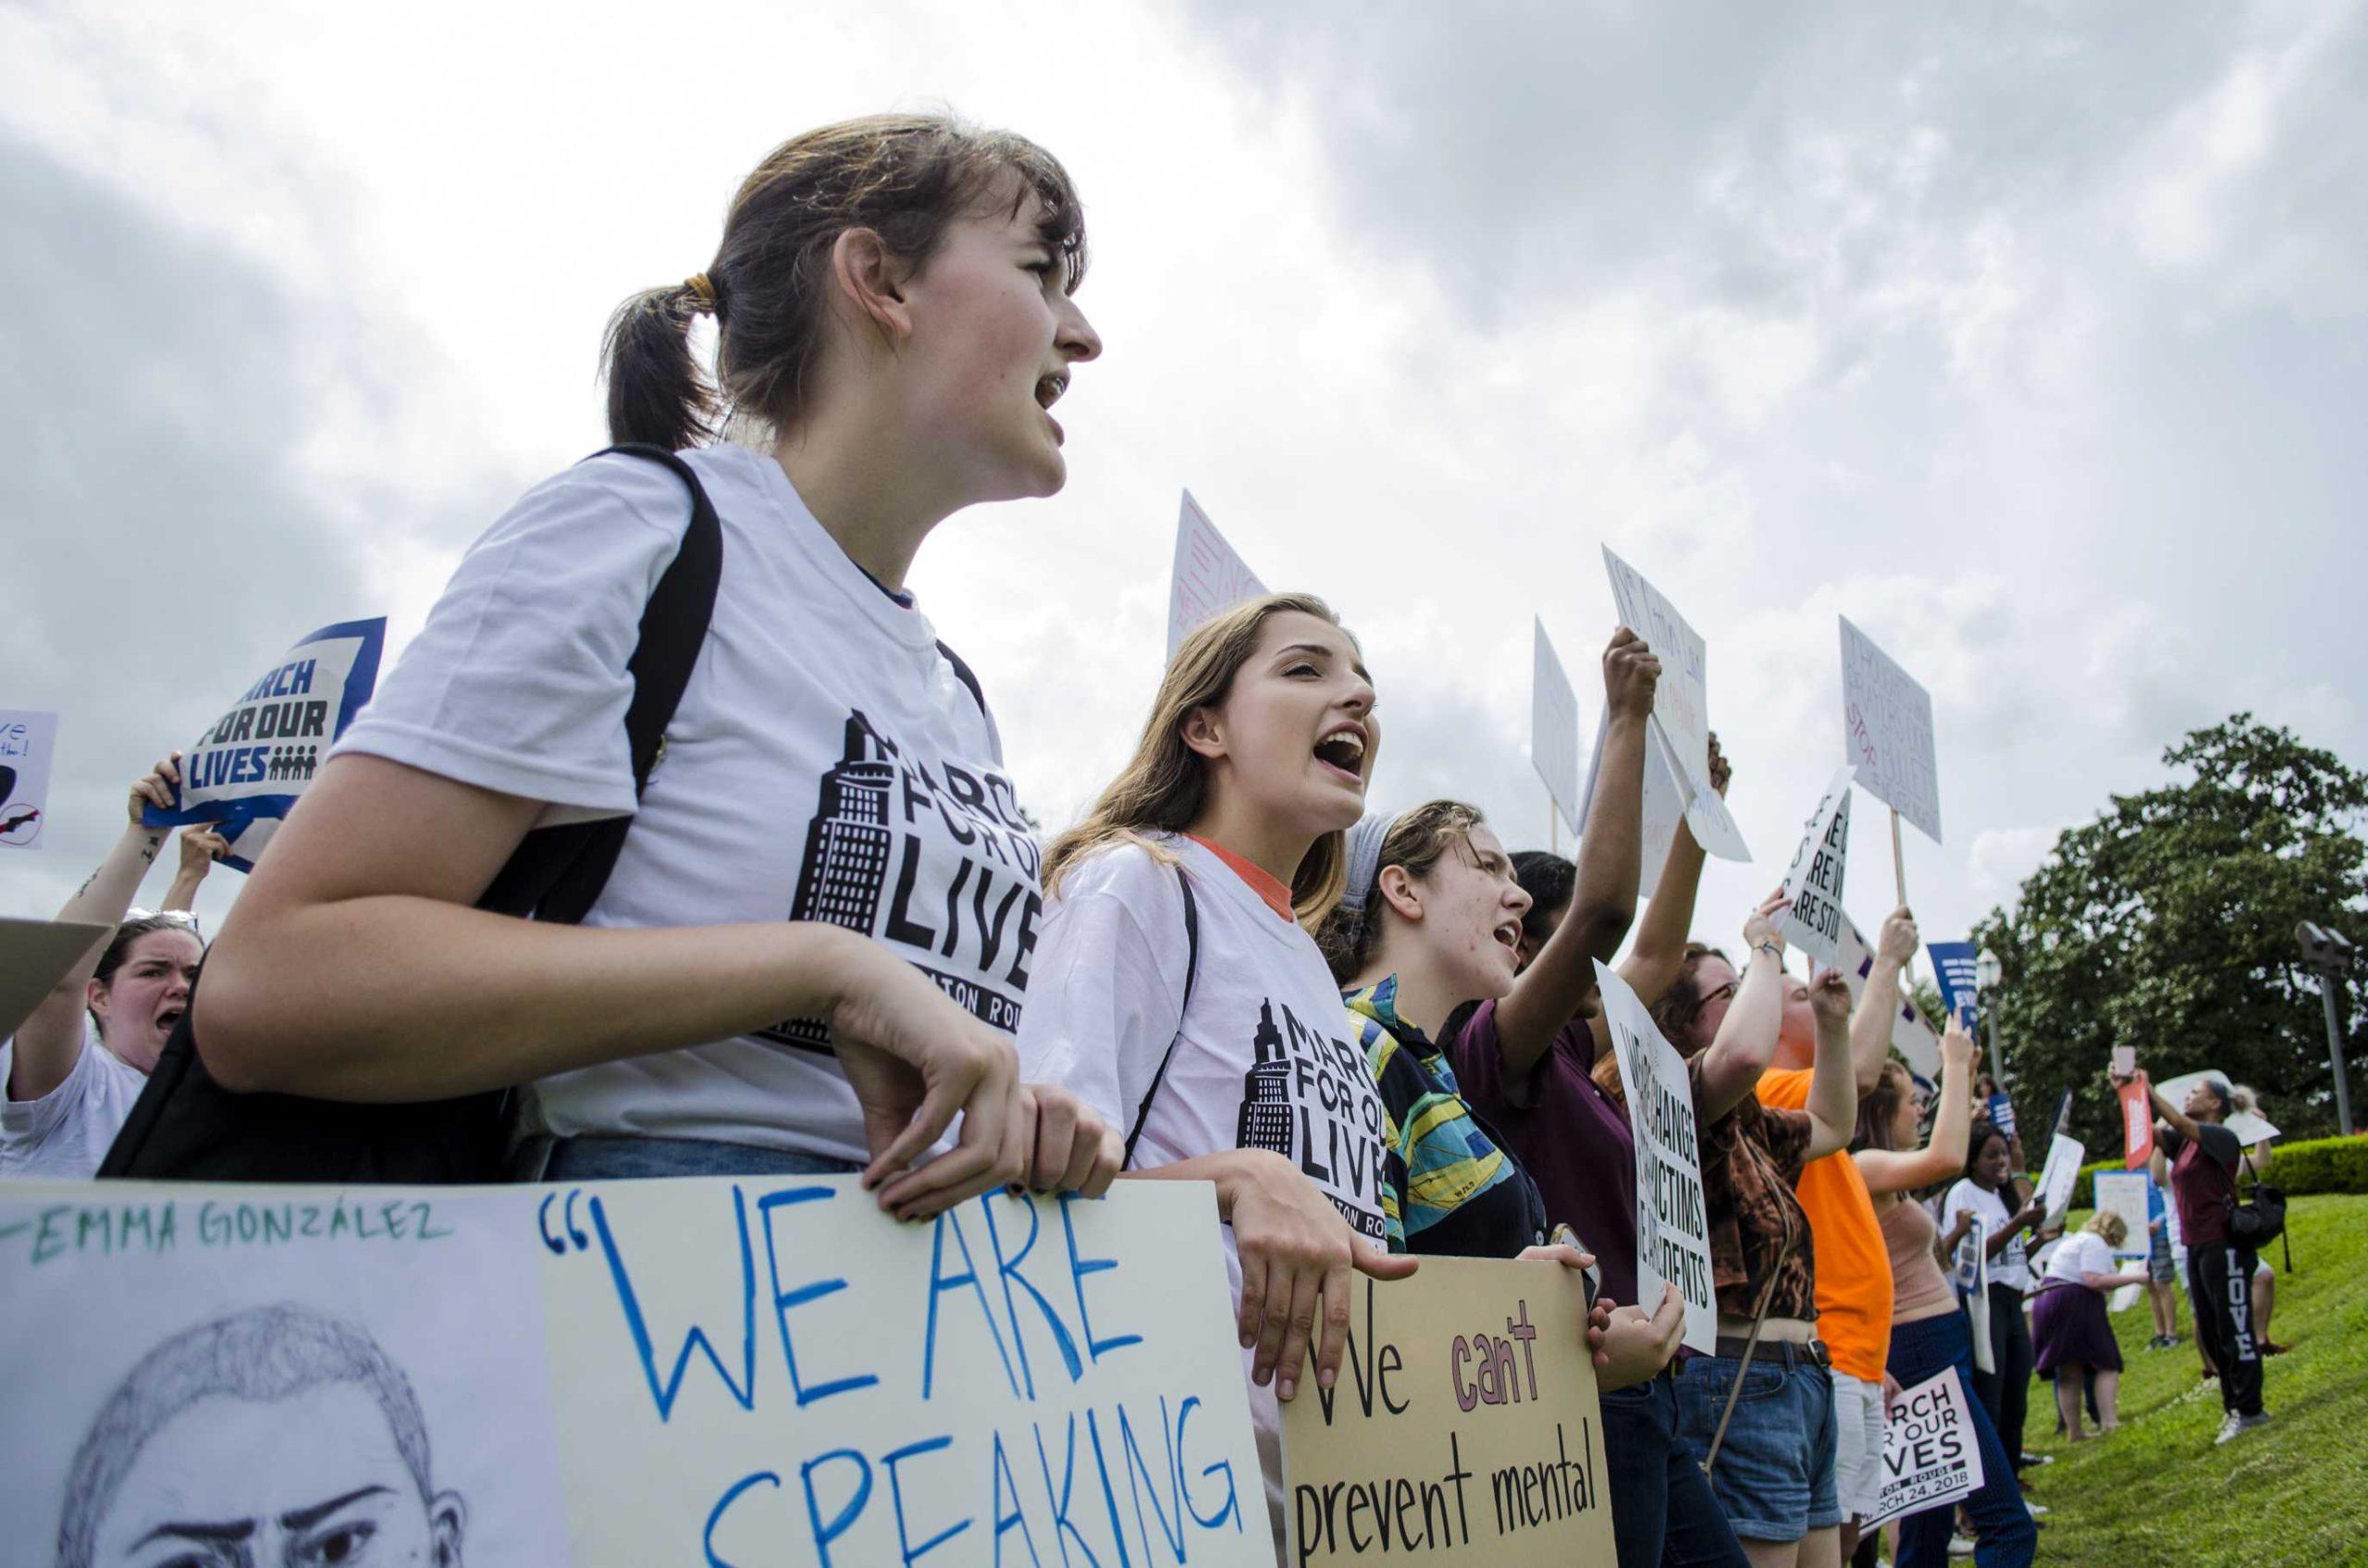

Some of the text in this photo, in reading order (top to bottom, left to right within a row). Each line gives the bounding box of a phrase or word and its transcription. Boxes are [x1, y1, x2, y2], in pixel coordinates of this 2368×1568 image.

[255, 700, 327, 740] OUR
[190, 746, 271, 790] LIVES
[1294, 1056, 1355, 1124] FOR
[1331, 1199, 1359, 1228] TON
[923, 1185, 1144, 1402] ARE
[2226, 1248, 2256, 1361] LOVE
[1450, 1300, 1538, 1413] can't
[1883, 1383, 1951, 1429] RCH
[1905, 1407, 1958, 1440] OUR
[1295, 1416, 1596, 1568] prevent mental
[1935, 1471, 1968, 1492] 2018
